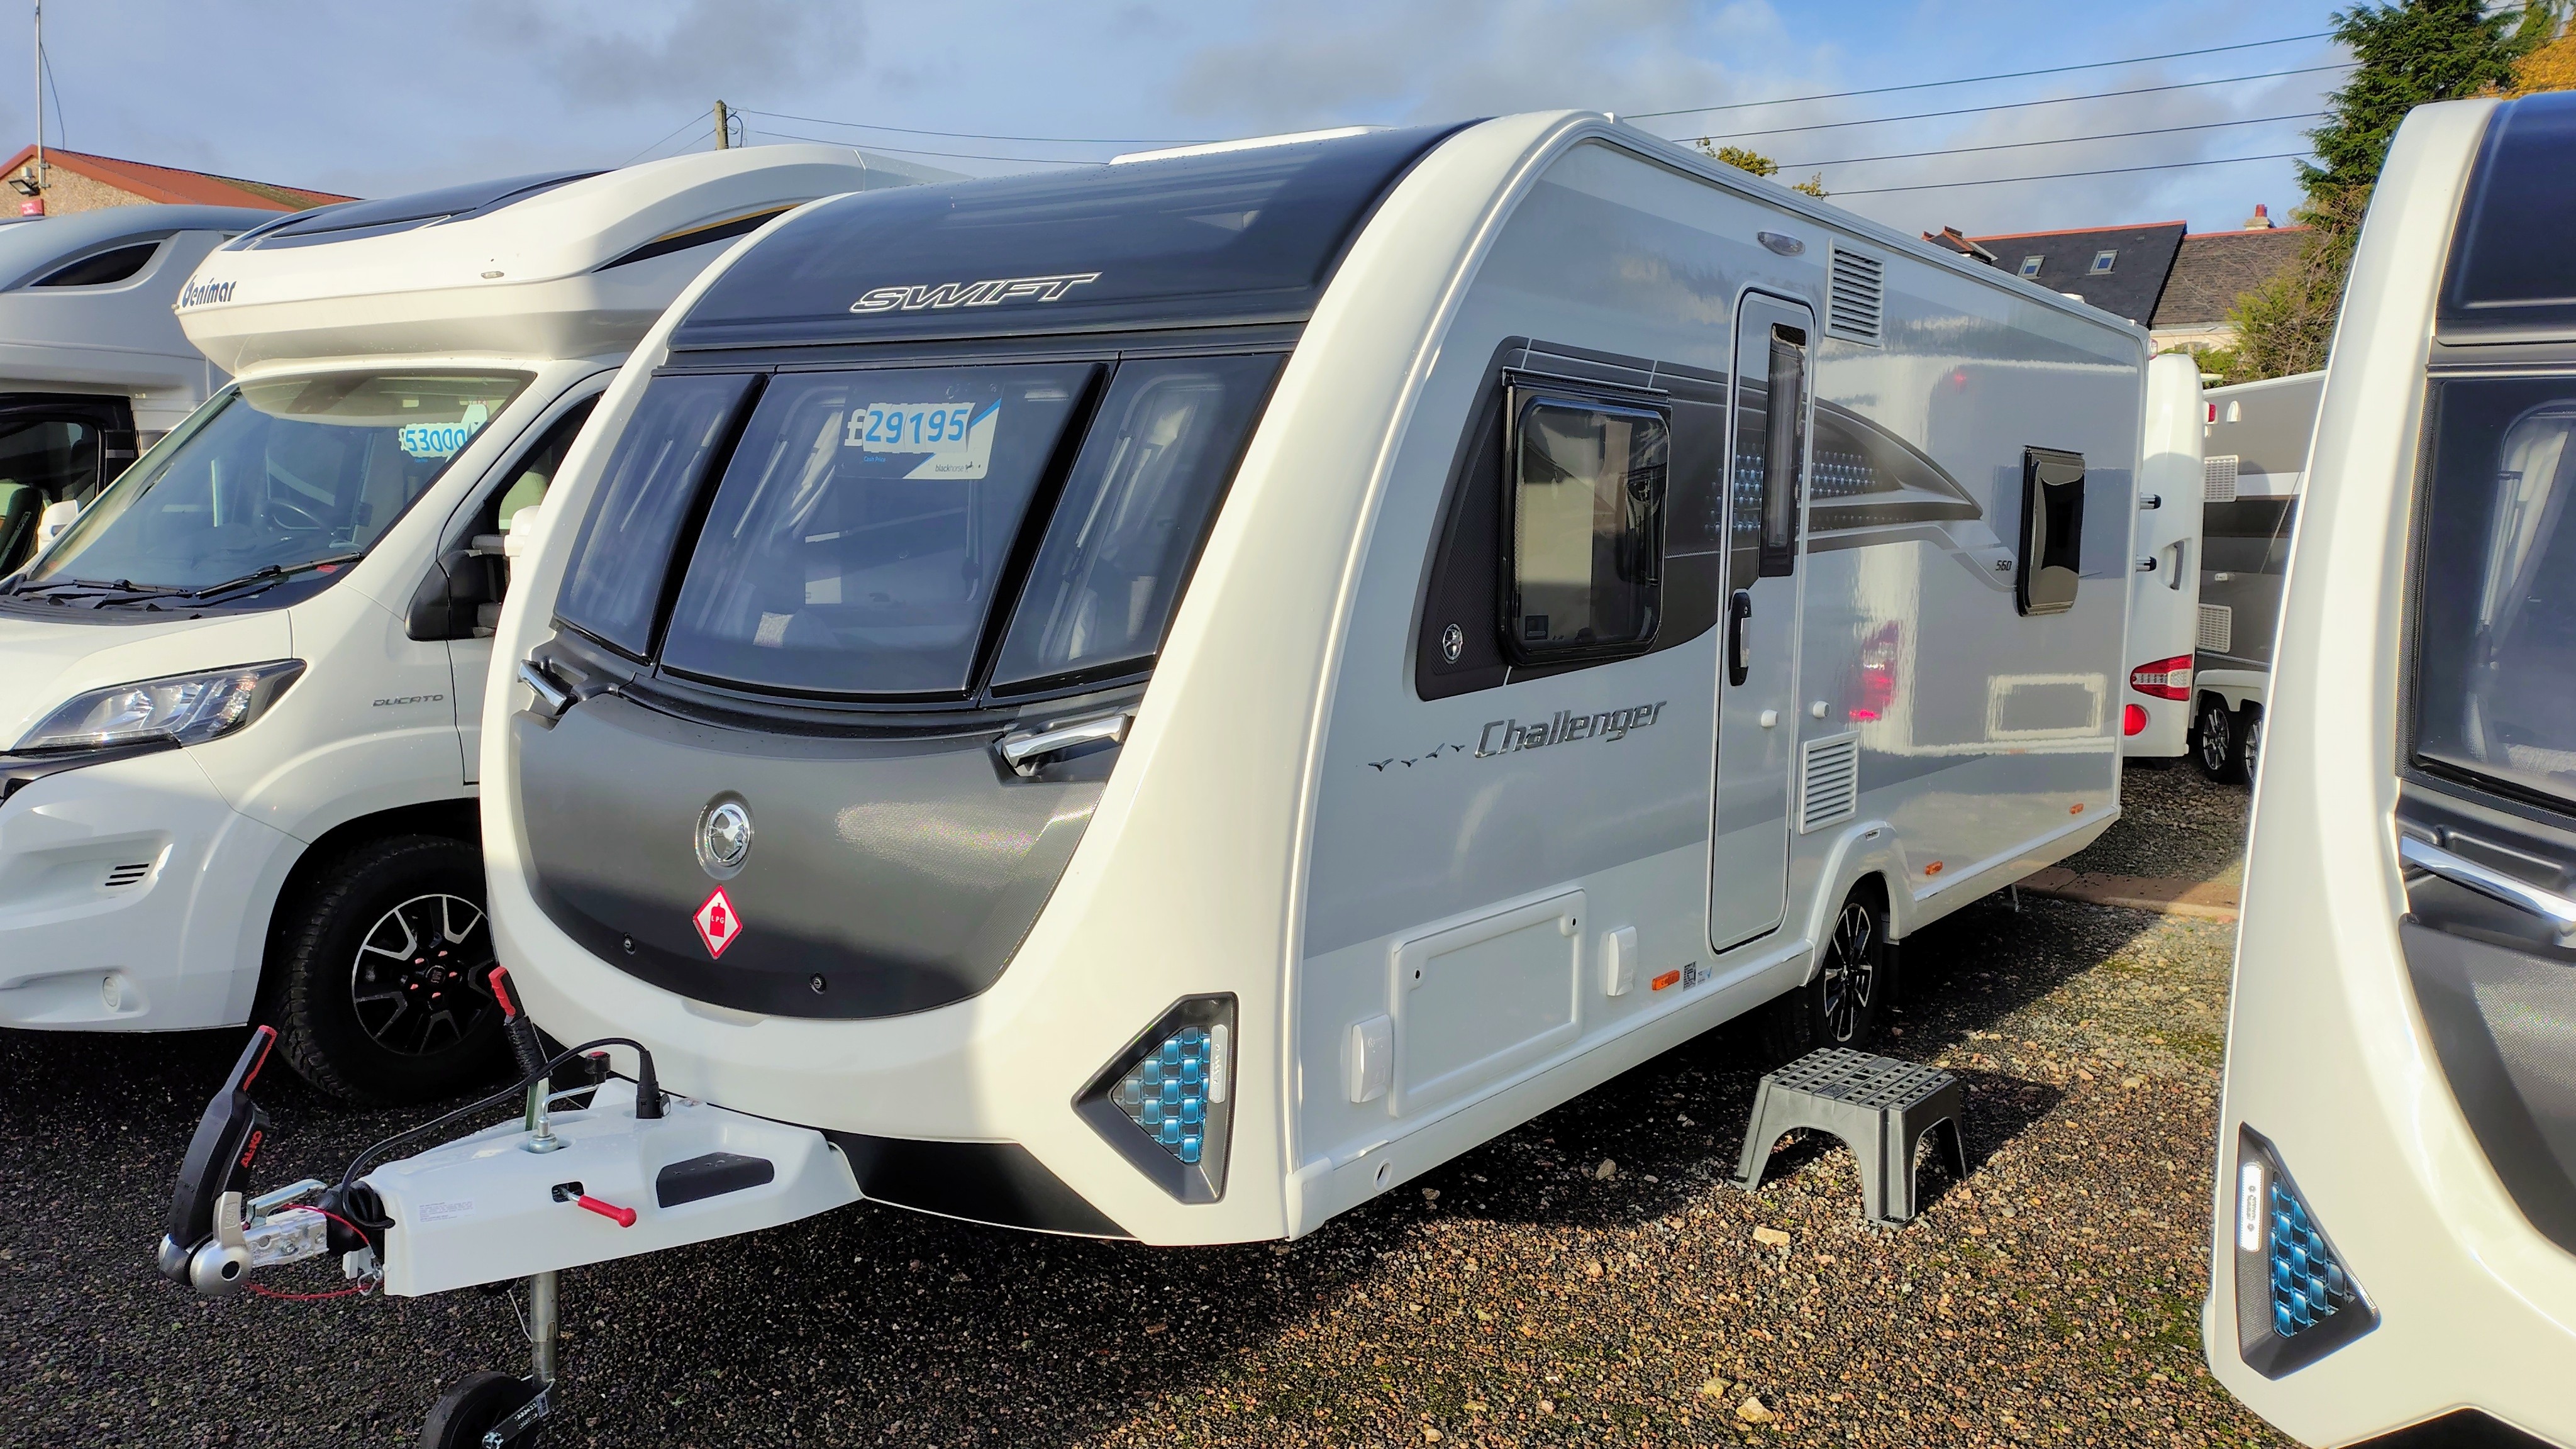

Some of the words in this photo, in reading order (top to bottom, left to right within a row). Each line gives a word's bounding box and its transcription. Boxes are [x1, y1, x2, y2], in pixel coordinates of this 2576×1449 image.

[849, 272, 1103, 314] SWIFT
[935, 464, 964, 472] blackhorse
[1995, 560, 2012, 571] 560
[372, 694, 444, 707] DUCATO
[1474, 700, 1668, 758] Challenger
[711, 914, 724, 924] LPG
